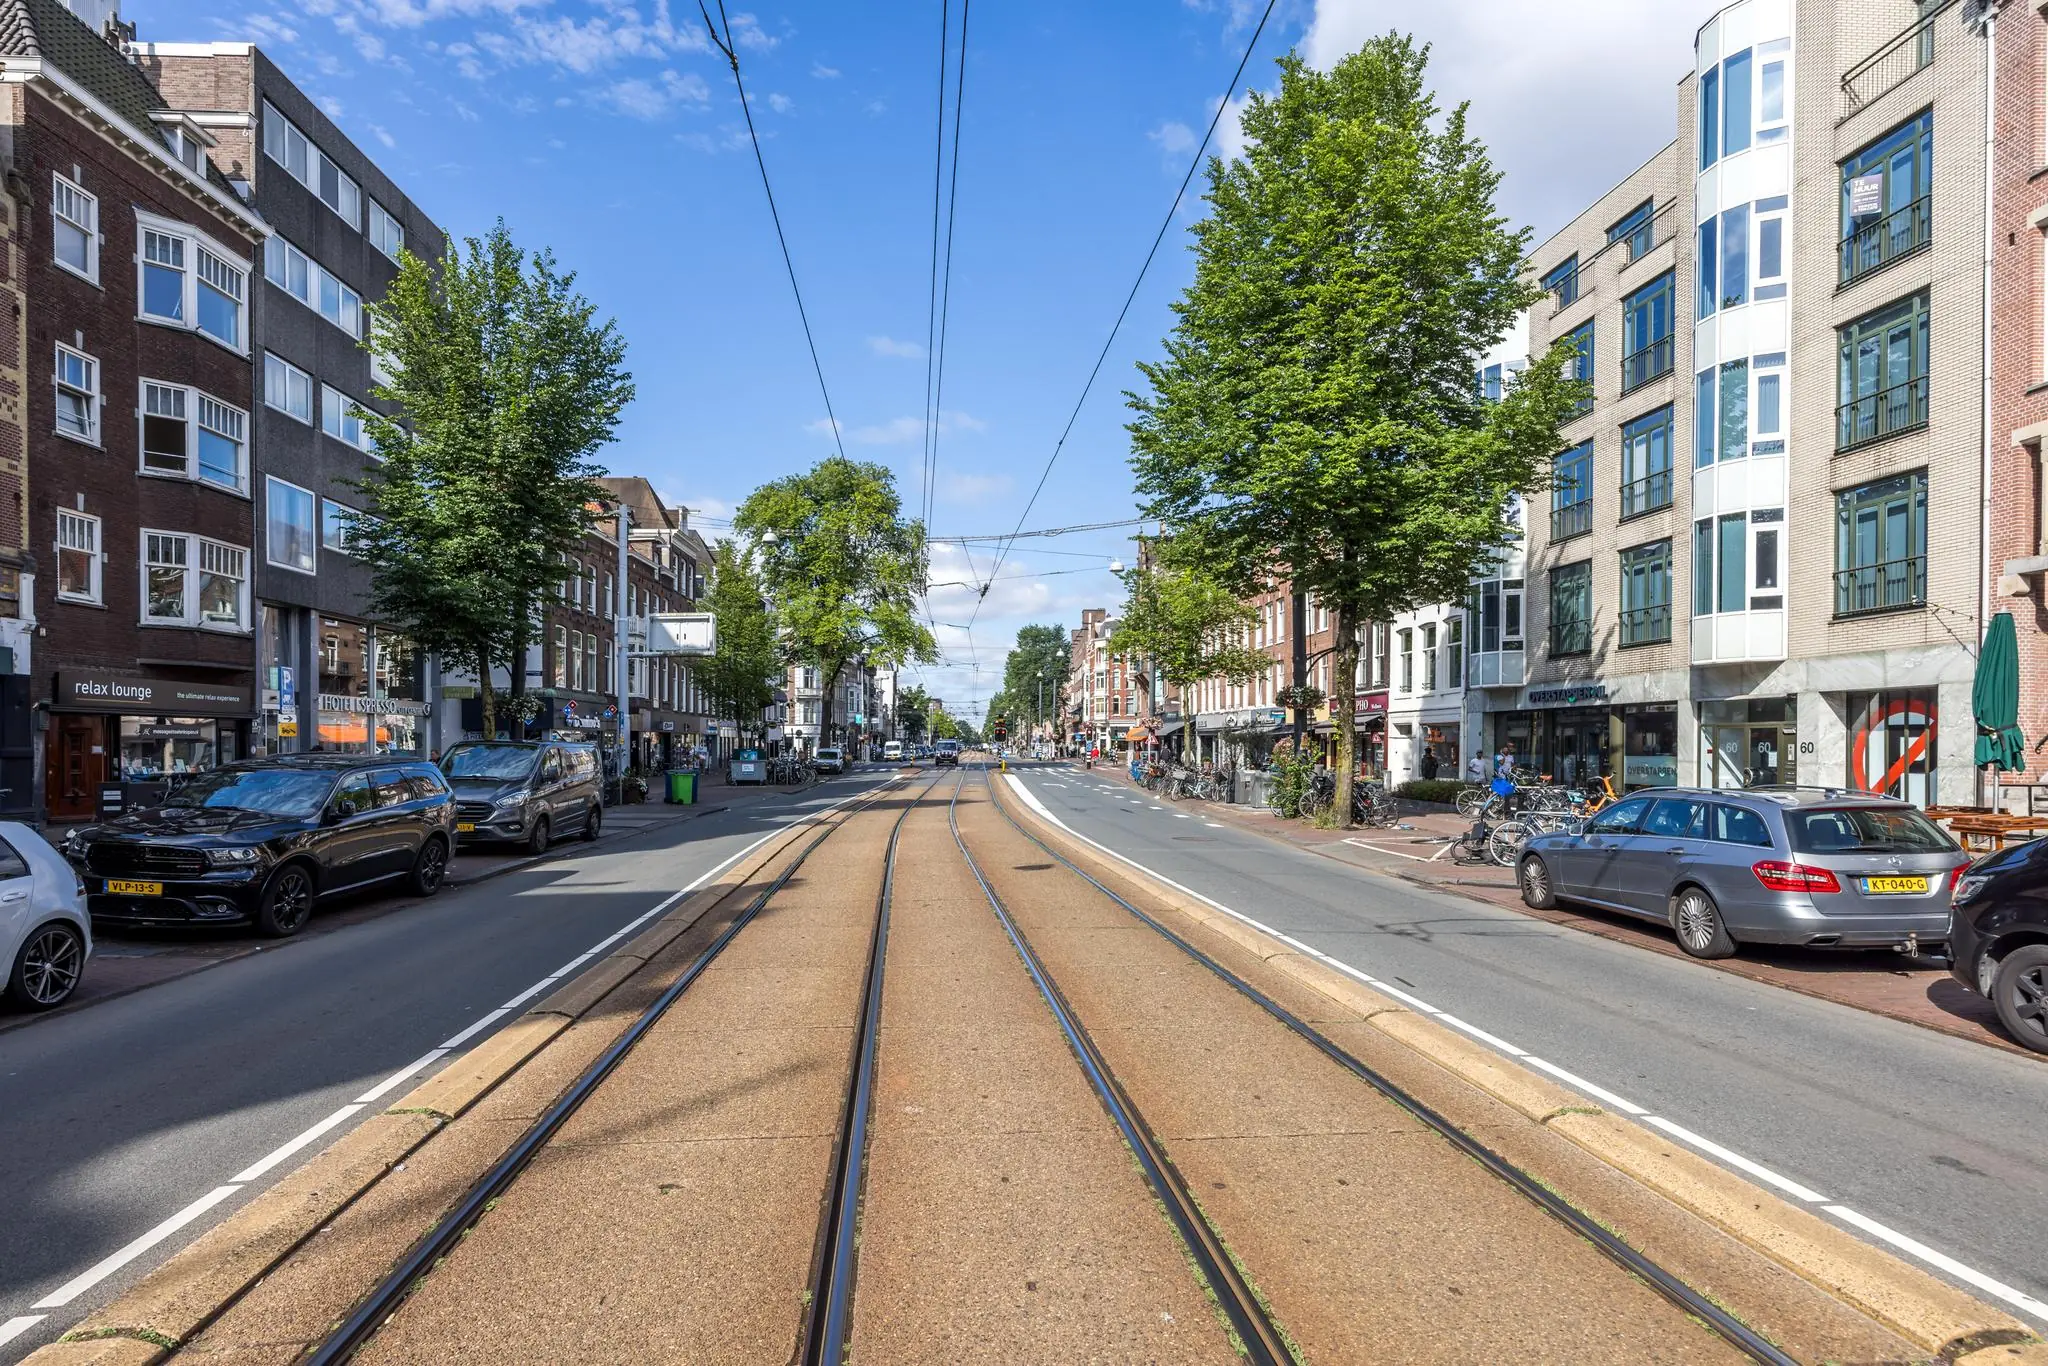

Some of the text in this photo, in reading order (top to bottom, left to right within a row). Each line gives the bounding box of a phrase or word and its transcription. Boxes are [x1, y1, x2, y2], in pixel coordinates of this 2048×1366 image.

[1853, 184, 1879, 193] HUUR
[283, 670, 291, 690] P
[75, 680, 152, 700] relax lounge
[186, 692, 204, 700] ultimate
[205, 693, 216, 701] relax
[217, 695, 240, 703] experience
[355, 697, 397, 714] ESPRESSO
[1725, 742, 1738, 753] 60
[1758, 741, 1771, 753] 60
[1800, 741, 1814, 754] 60
[112, 882, 154, 892] VLP-13-S
[1871, 879, 1924, 890] KT-040-G
